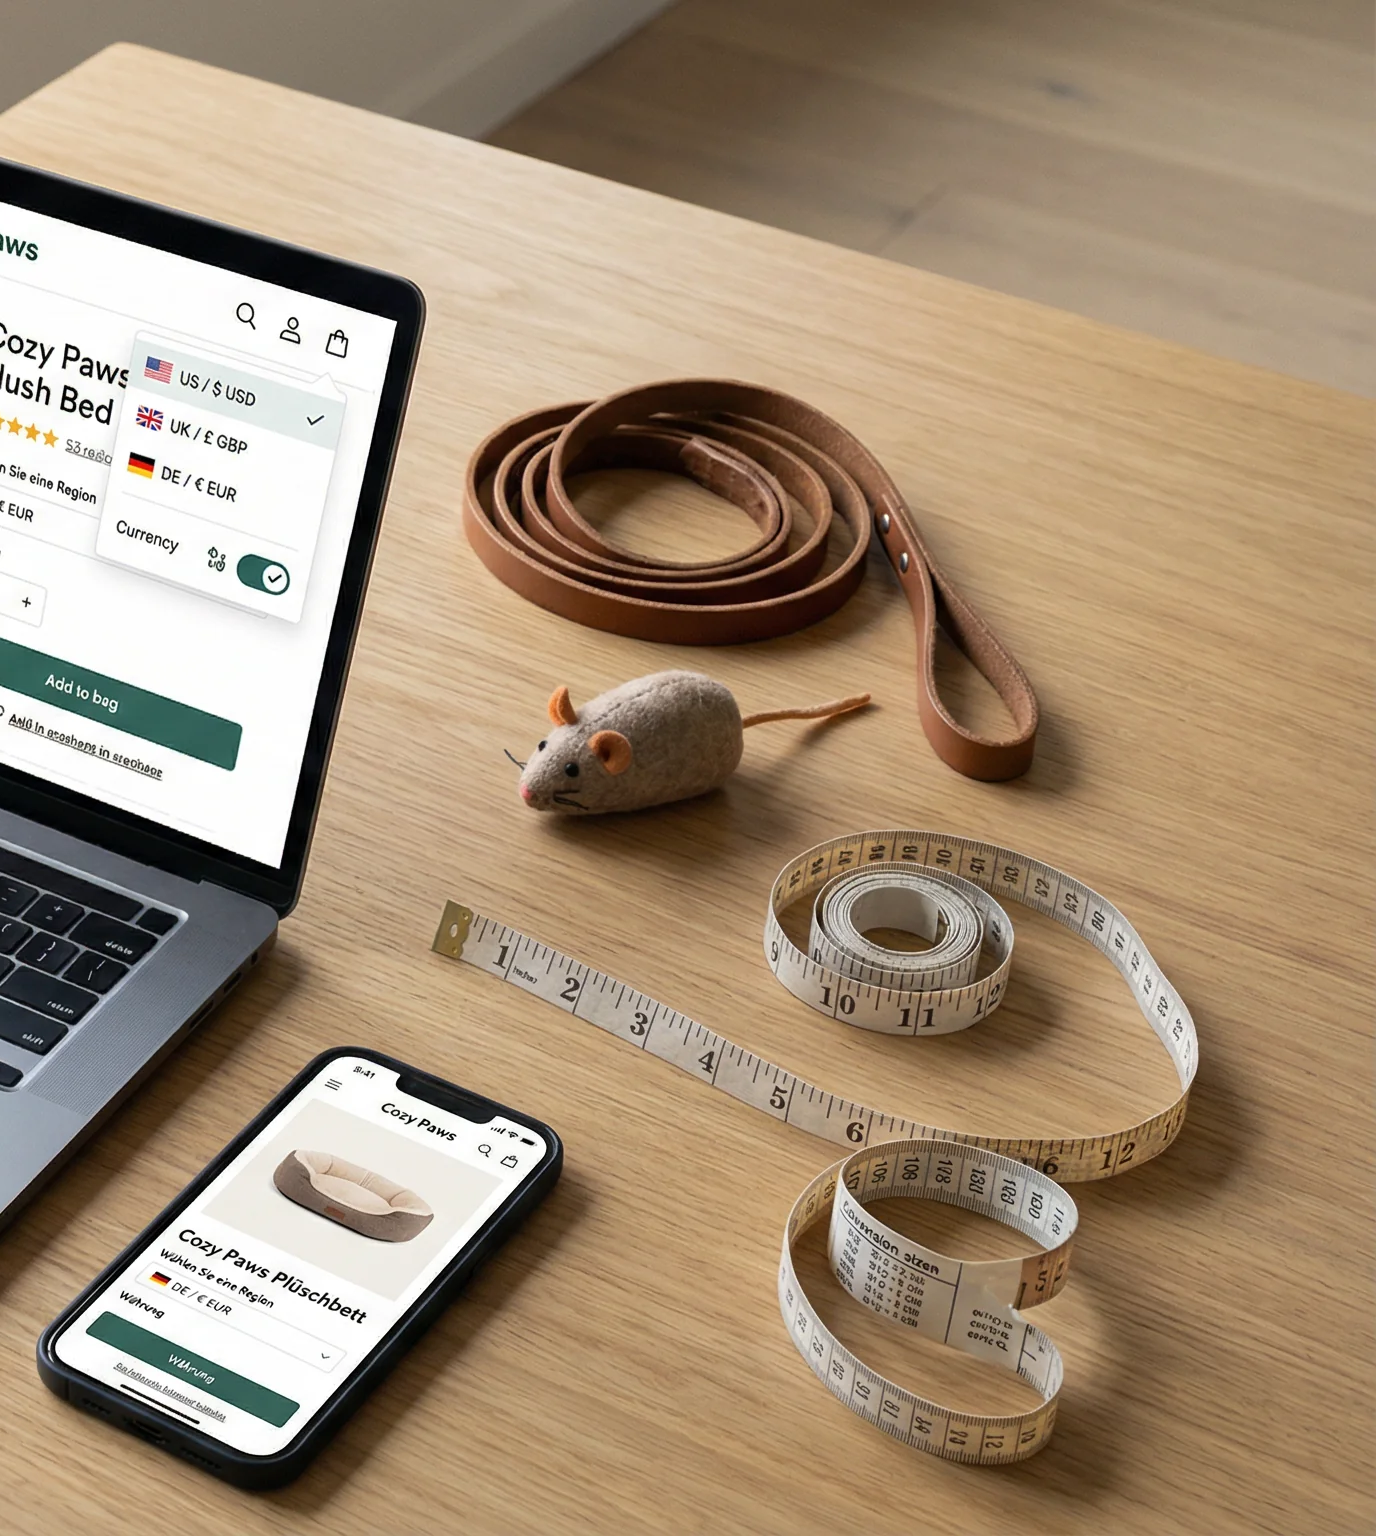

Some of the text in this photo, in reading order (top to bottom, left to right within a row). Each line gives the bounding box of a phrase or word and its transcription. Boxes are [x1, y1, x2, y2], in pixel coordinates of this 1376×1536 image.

[62, 344, 129, 389] Paws
[179, 370, 256, 406] US / $ USD
[60, 385, 114, 426] Bed
[169, 419, 248, 455] UK / £ GBP
[161, 466, 237, 503] DE / € EUR
[7, 503, 34, 522] EUR
[116, 519, 179, 555] Currency
[45, 674, 119, 714] Add to bag
[492, 945, 509, 970] 1
[559, 977, 581, 1003] 2
[819, 985, 856, 1015] 10
[629, 1012, 649, 1037] 3
[896, 1007, 936, 1028] 11
[698, 1050, 715, 1074] 4
[769, 1086, 788, 1110] 5
[381, 1103, 457, 1142] Cozy Paws
[846, 1122, 865, 1143] 6
[1042, 1156, 1059, 1176] 6
[1099, 1142, 1136, 1171] 12
[178, 1229, 223, 1258] Cozy
[222, 1249, 270, 1279] Paws
[171, 1282, 190, 1296] DE
[206, 1299, 232, 1316] EUR
